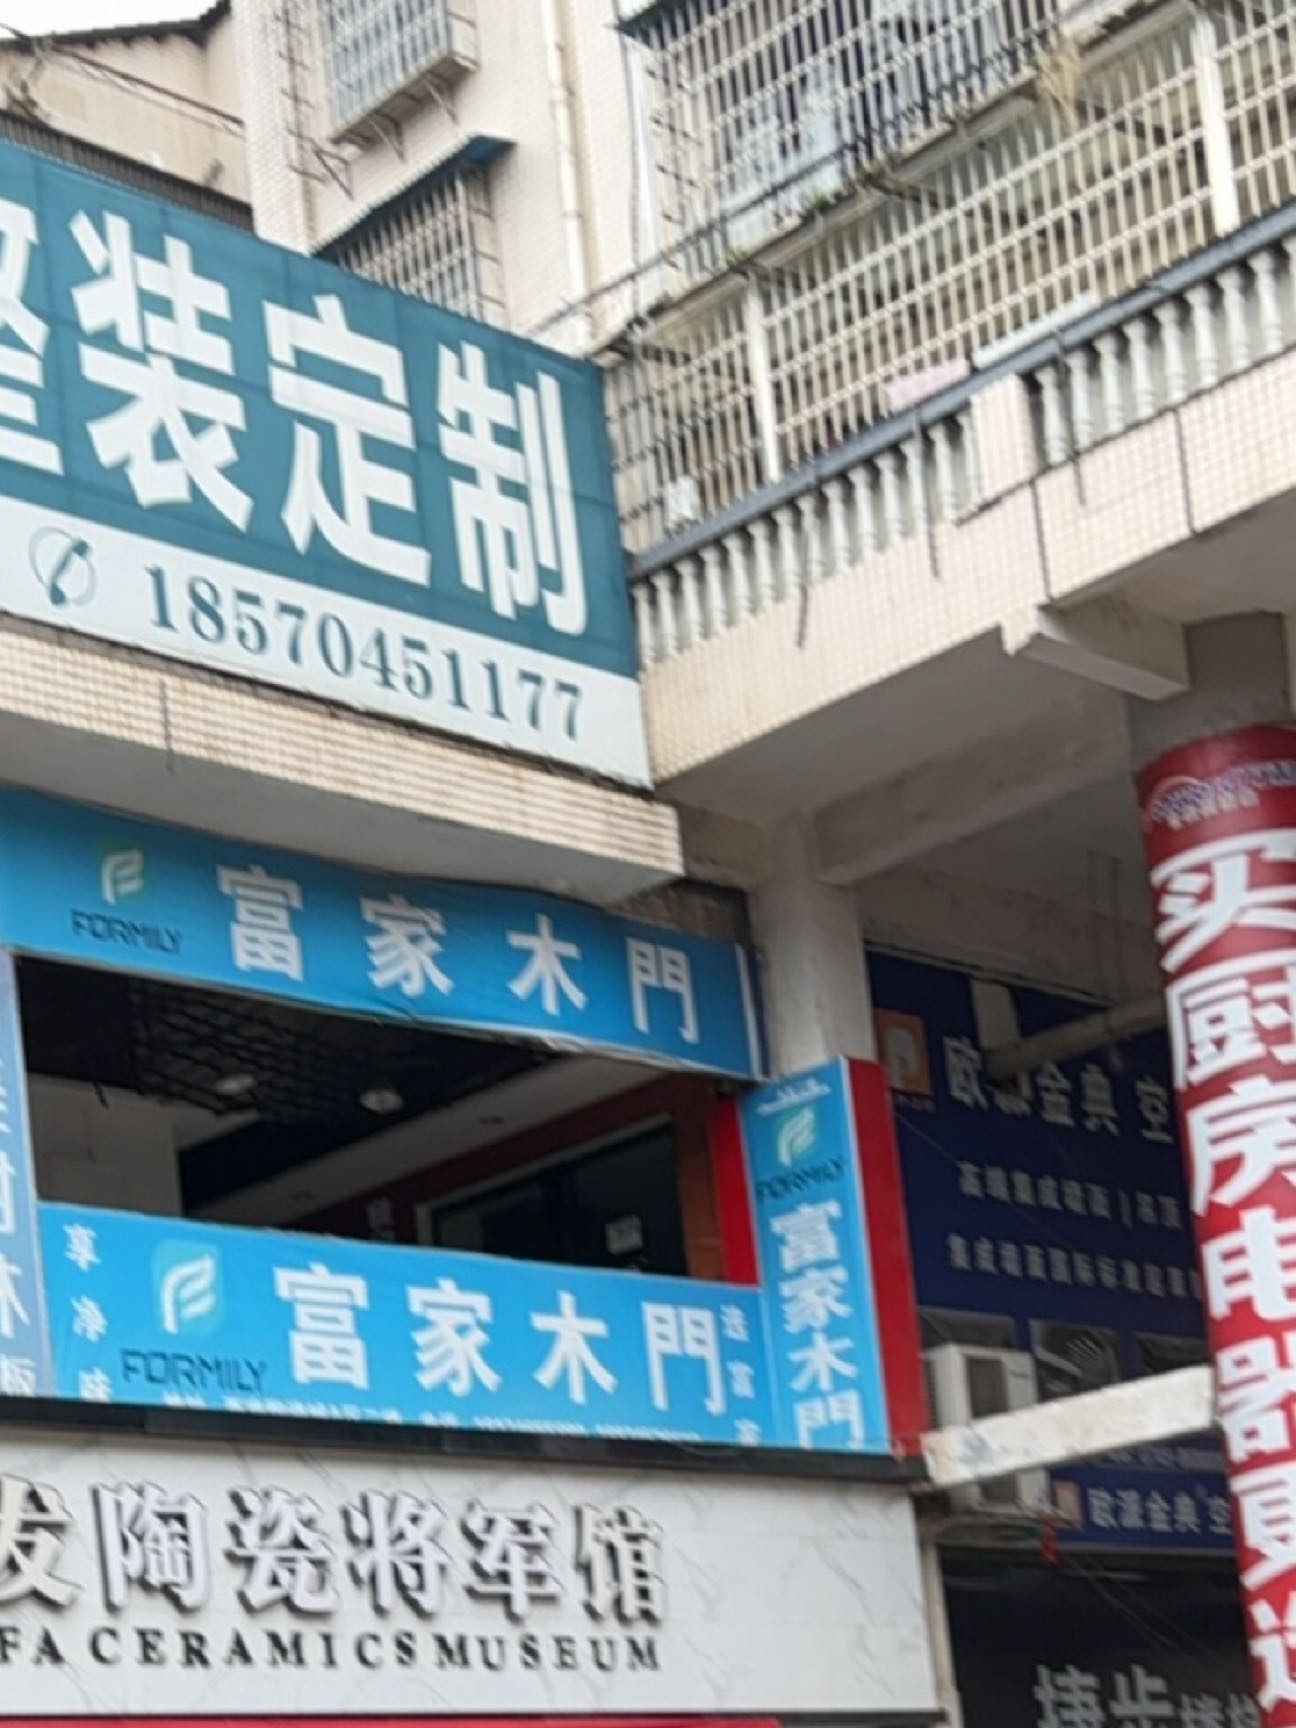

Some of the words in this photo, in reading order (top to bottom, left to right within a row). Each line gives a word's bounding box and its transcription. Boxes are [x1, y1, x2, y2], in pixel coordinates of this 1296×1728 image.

[146, 562, 583, 742] 18570451177
[71, 909, 183, 956] FORMILY
[217, 864, 699, 1045] 富家木門
[121, 1349, 269, 1393] FORMILY
[274, 1263, 726, 1417] 富家木門
[769, 1199, 864, 1450] 富家木門
